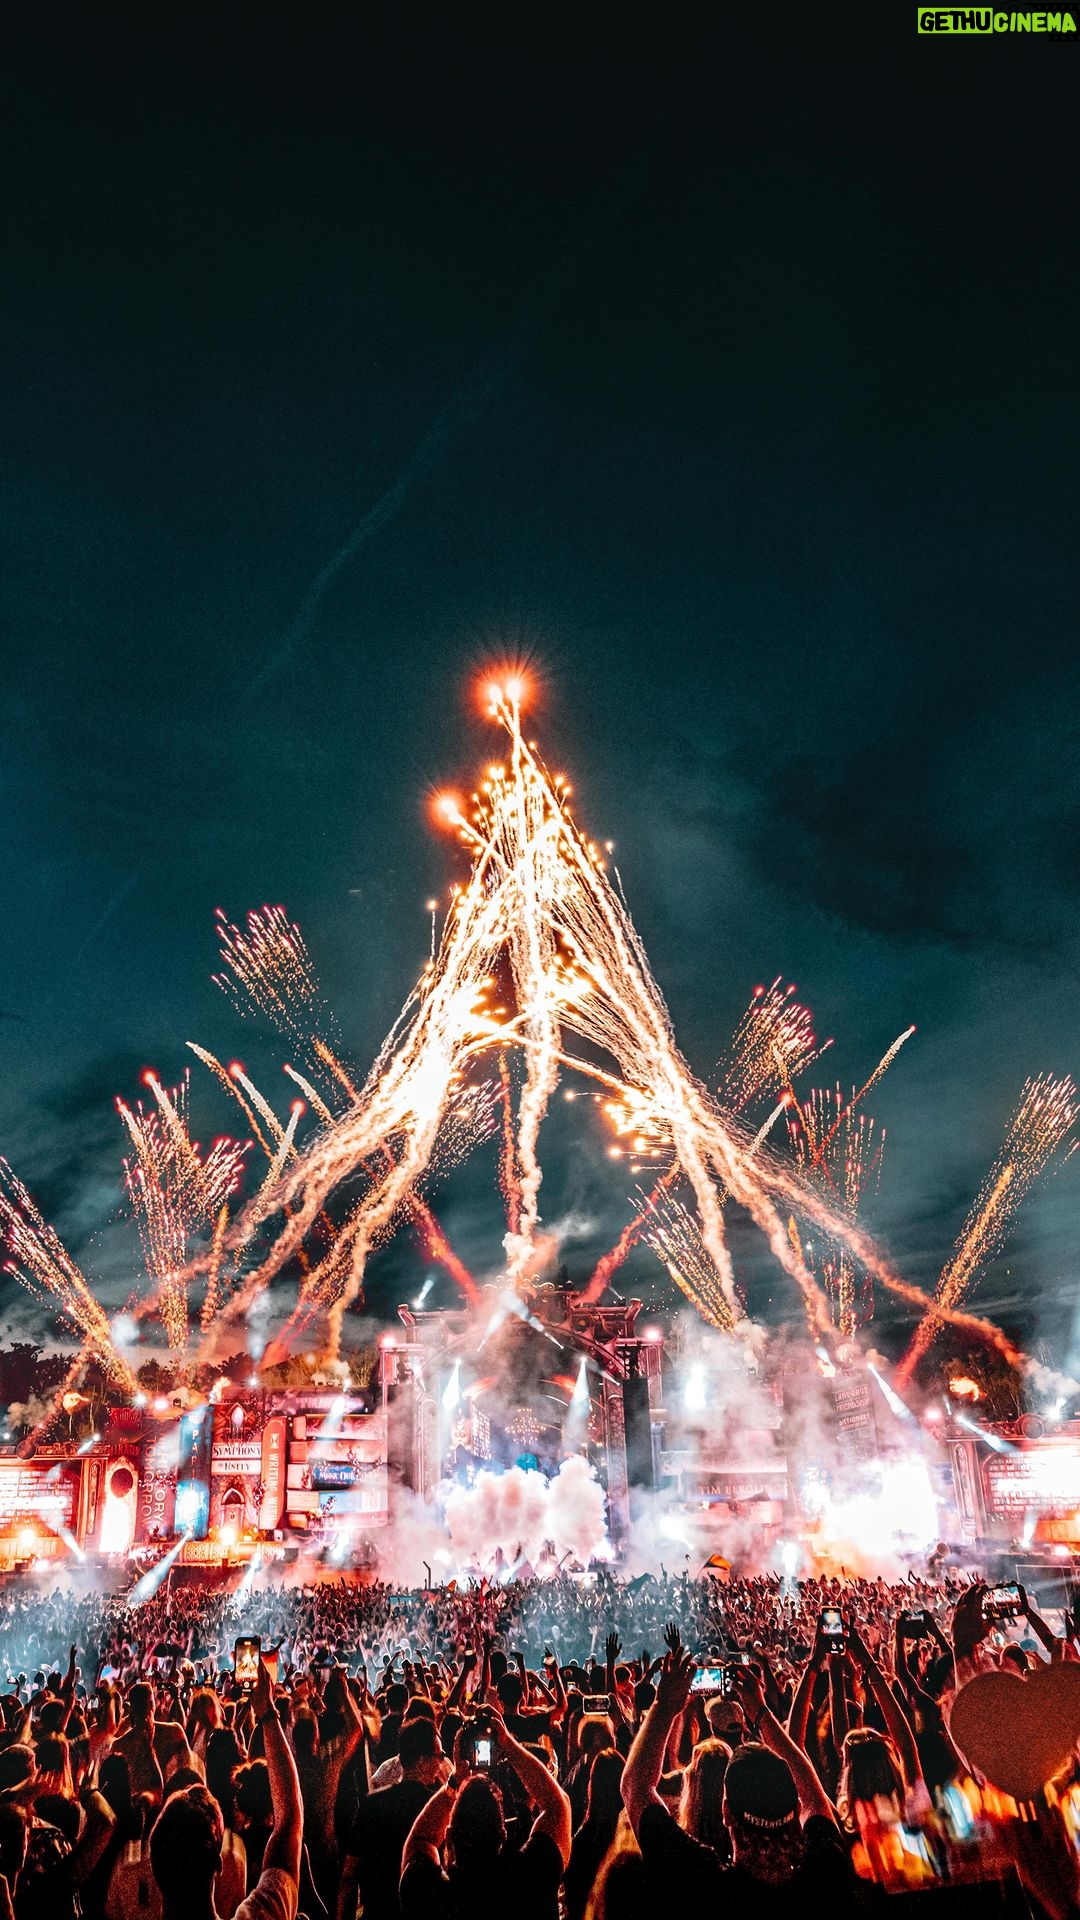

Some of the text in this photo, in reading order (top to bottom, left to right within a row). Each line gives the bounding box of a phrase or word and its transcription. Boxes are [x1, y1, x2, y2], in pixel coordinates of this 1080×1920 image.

[835, 1386, 869, 1402] LANGUAGE
[213, 1446, 261, 1457] SYMPHONY
[698, 1484, 776, 1495] TIM BERGLIN
